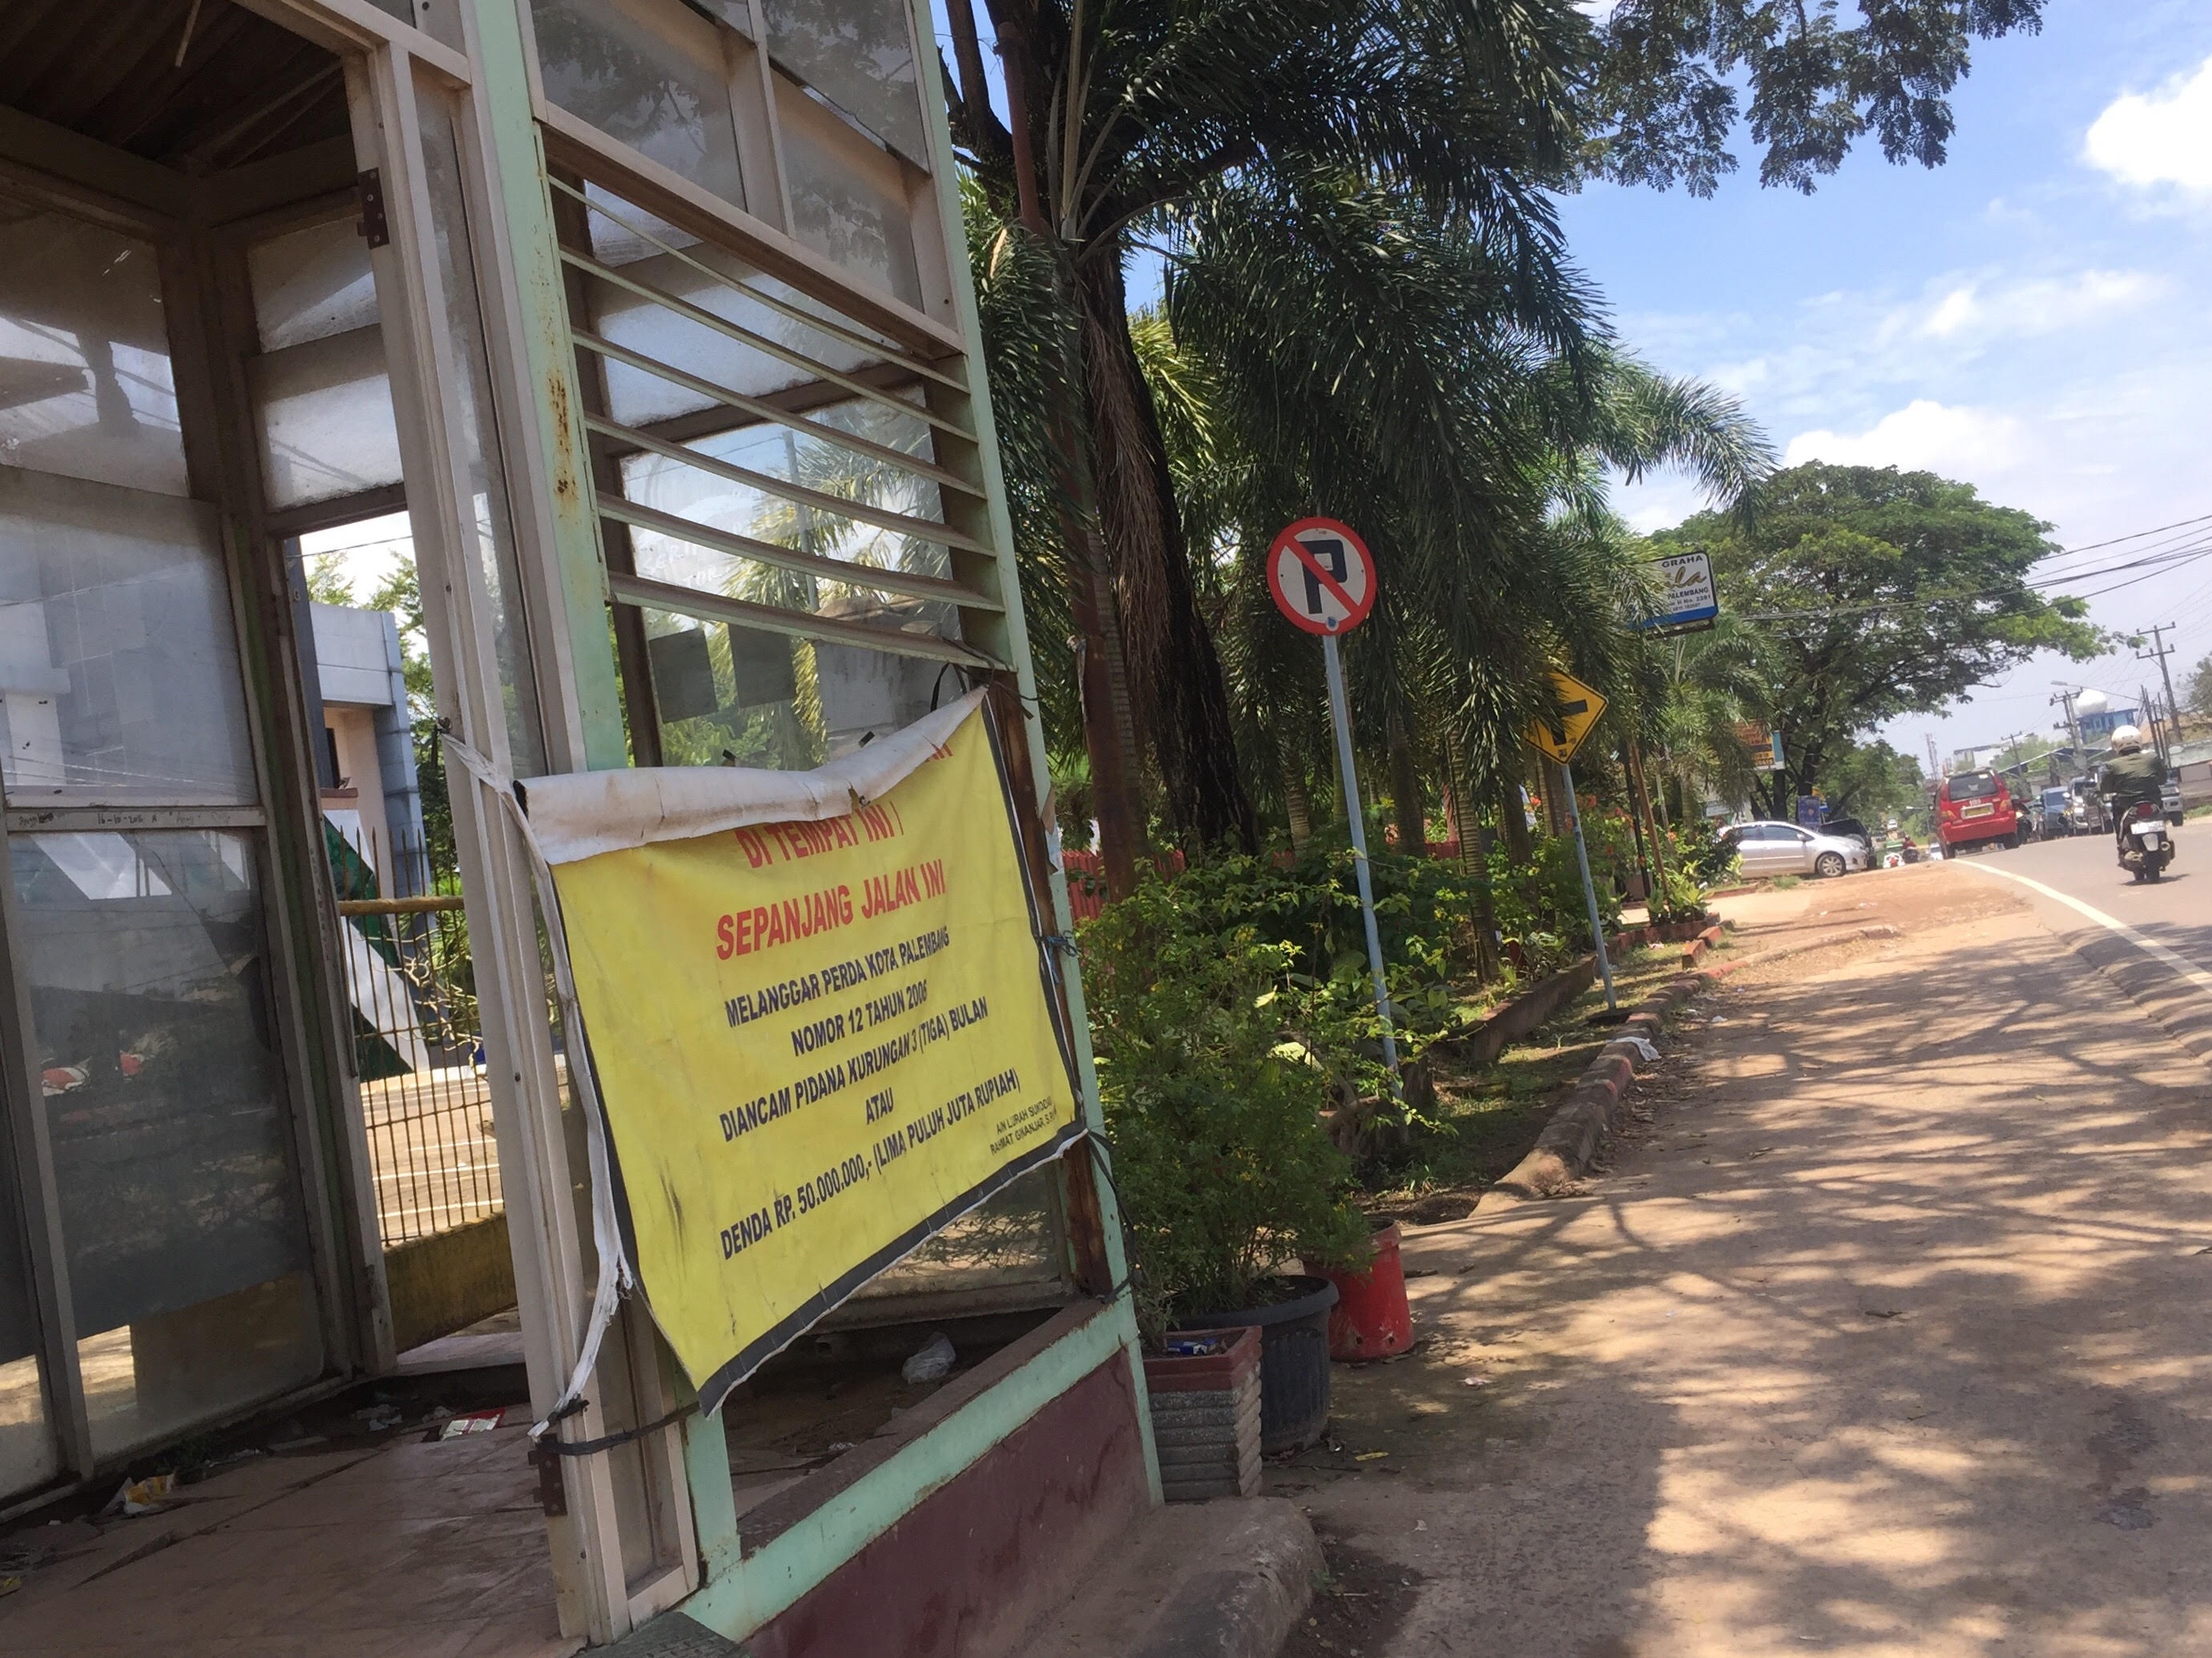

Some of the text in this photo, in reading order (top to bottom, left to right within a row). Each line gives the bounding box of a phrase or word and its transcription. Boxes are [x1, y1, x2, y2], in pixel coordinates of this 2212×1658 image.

[1298, 539, 1348, 615] P
[1661, 555, 1703, 568] GRAHA
[1667, 587, 1709, 599] PALEMBANG
[735, 827, 773, 869] DI
[763, 813, 860, 859] TEMPAT
[716, 858, 946, 961] SEPANJANG JALAN INI
[724, 925, 949, 1028] MELANGGAR PERDA KOTA PALEMBANG
[791, 1013, 845, 1057] NOMOR
[848, 1006, 864, 1034] 12
[865, 989, 906, 1027] TAHUN
[719, 995, 989, 1143] DIANCAM PIDANA KURUNGAN 3 (TIGA) BULAN
[865, 1087, 895, 1125] ATAU
[720, 1207, 773, 1261] DENDA
[774, 1195, 796, 1229] RP.
[872, 1130, 907, 1175] (LIMA
[906, 1107, 945, 1149] PULUH
[946, 1091, 976, 1126] JUTA
[973, 1067, 1021, 1110] RUPIAH)
[989, 1132, 1013, 1156] RAHMAT
